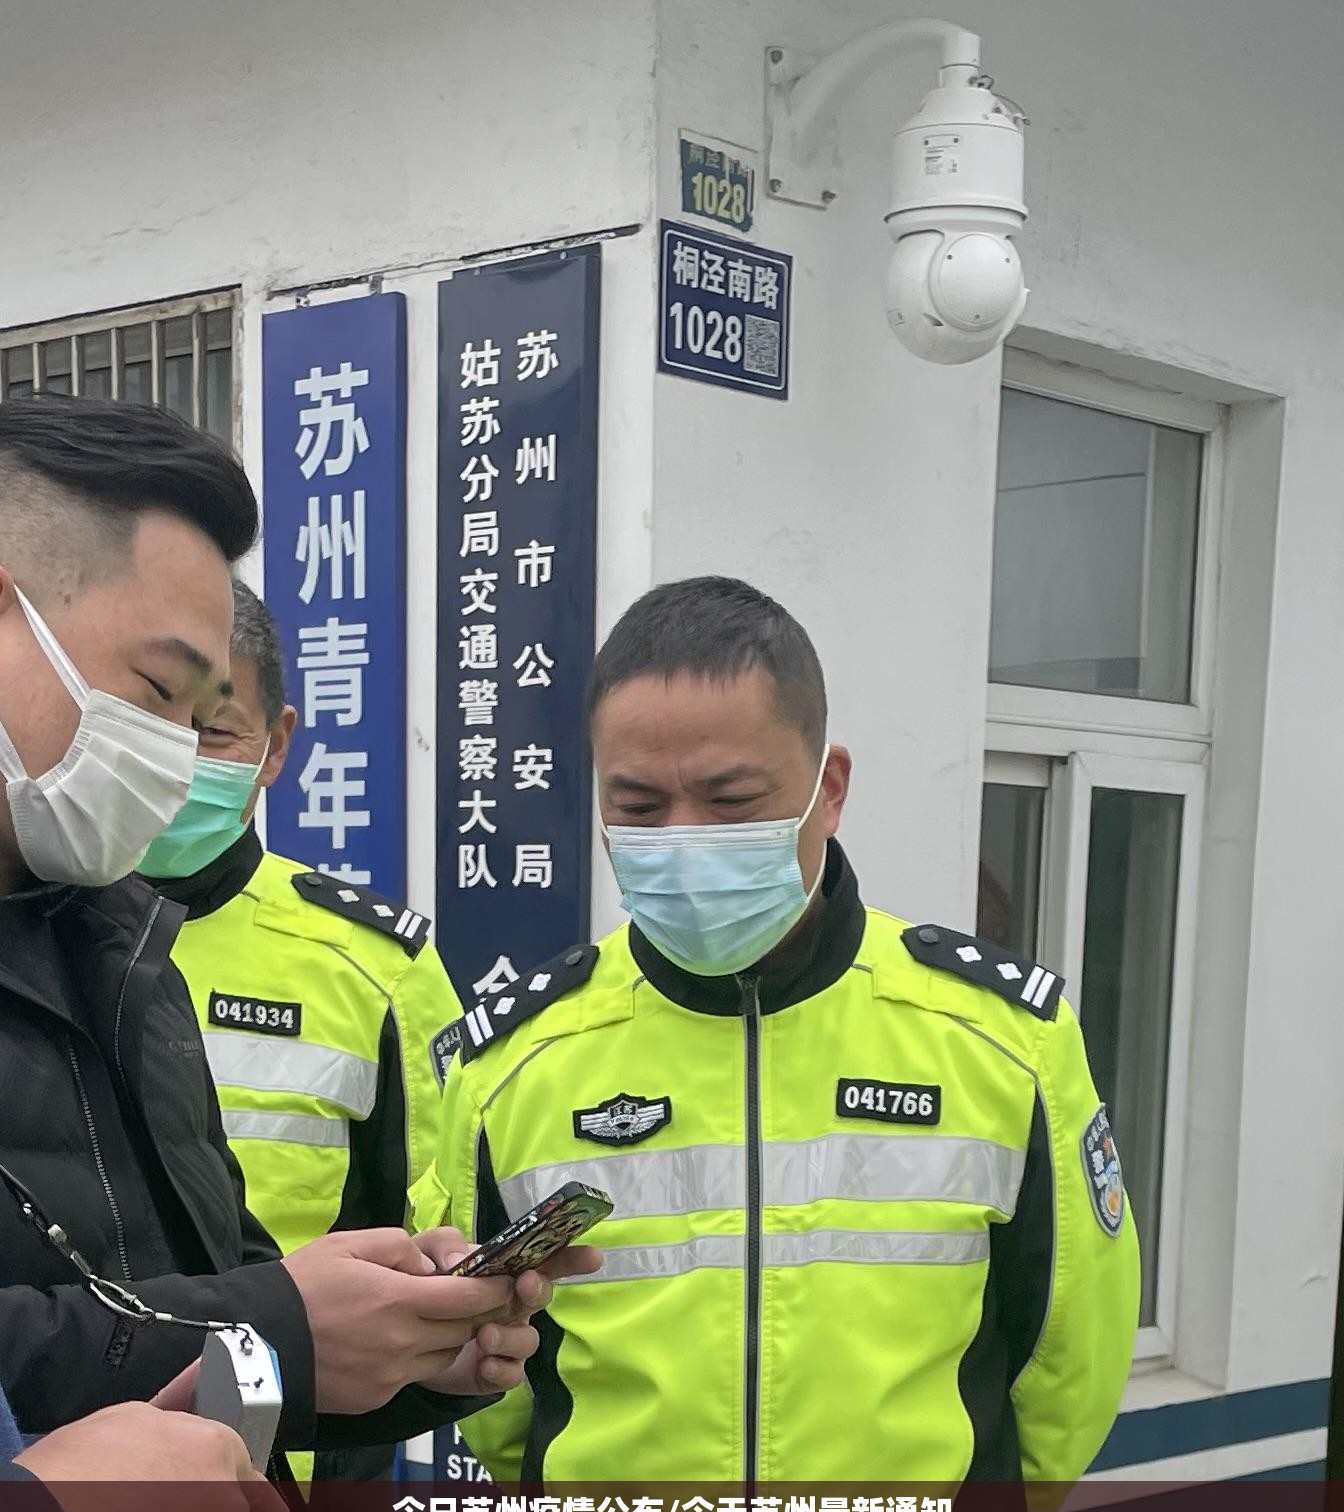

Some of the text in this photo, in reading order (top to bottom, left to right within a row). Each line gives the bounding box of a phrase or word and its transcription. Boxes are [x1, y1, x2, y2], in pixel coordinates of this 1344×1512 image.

[691, 171, 745, 224] 1028
[672, 240, 780, 310] 桐泾南路
[669, 301, 743, 364] 1028
[457, 338, 502, 890] 姑苏分局交通警察大队
[511, 328, 559, 889] 苏州市公安局
[214, 999, 294, 1029] 041934
[844, 1085, 934, 1117] 041766
